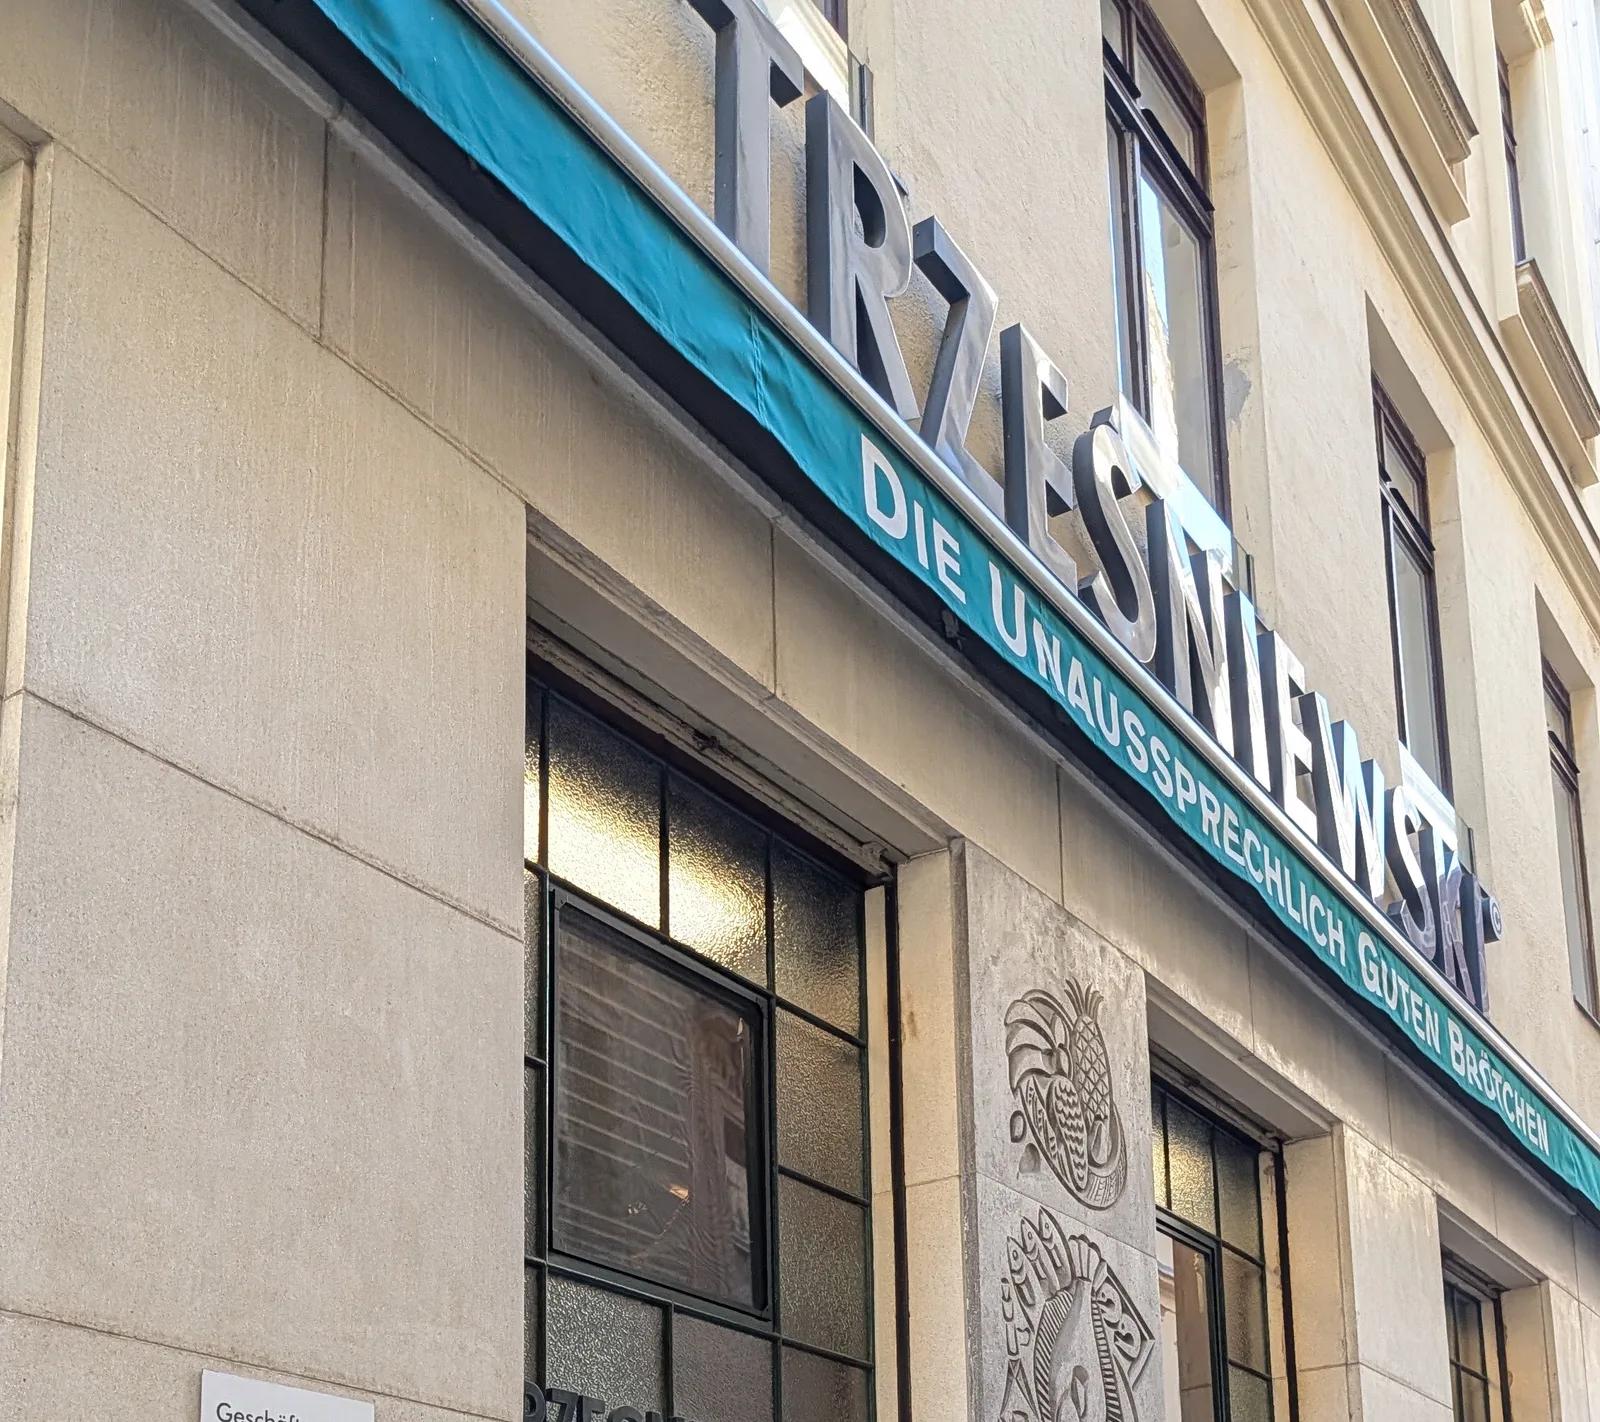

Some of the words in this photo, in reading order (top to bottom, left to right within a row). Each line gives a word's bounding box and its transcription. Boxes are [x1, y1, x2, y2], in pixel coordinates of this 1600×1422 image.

[860, 432, 967, 606] DIE
[988, 560, 1347, 967] UNAUSSPRECHLICH
[1357, 931, 1441, 1054] GUTEN
[1448, 1022, 1550, 1157] BRÖTCHEN
